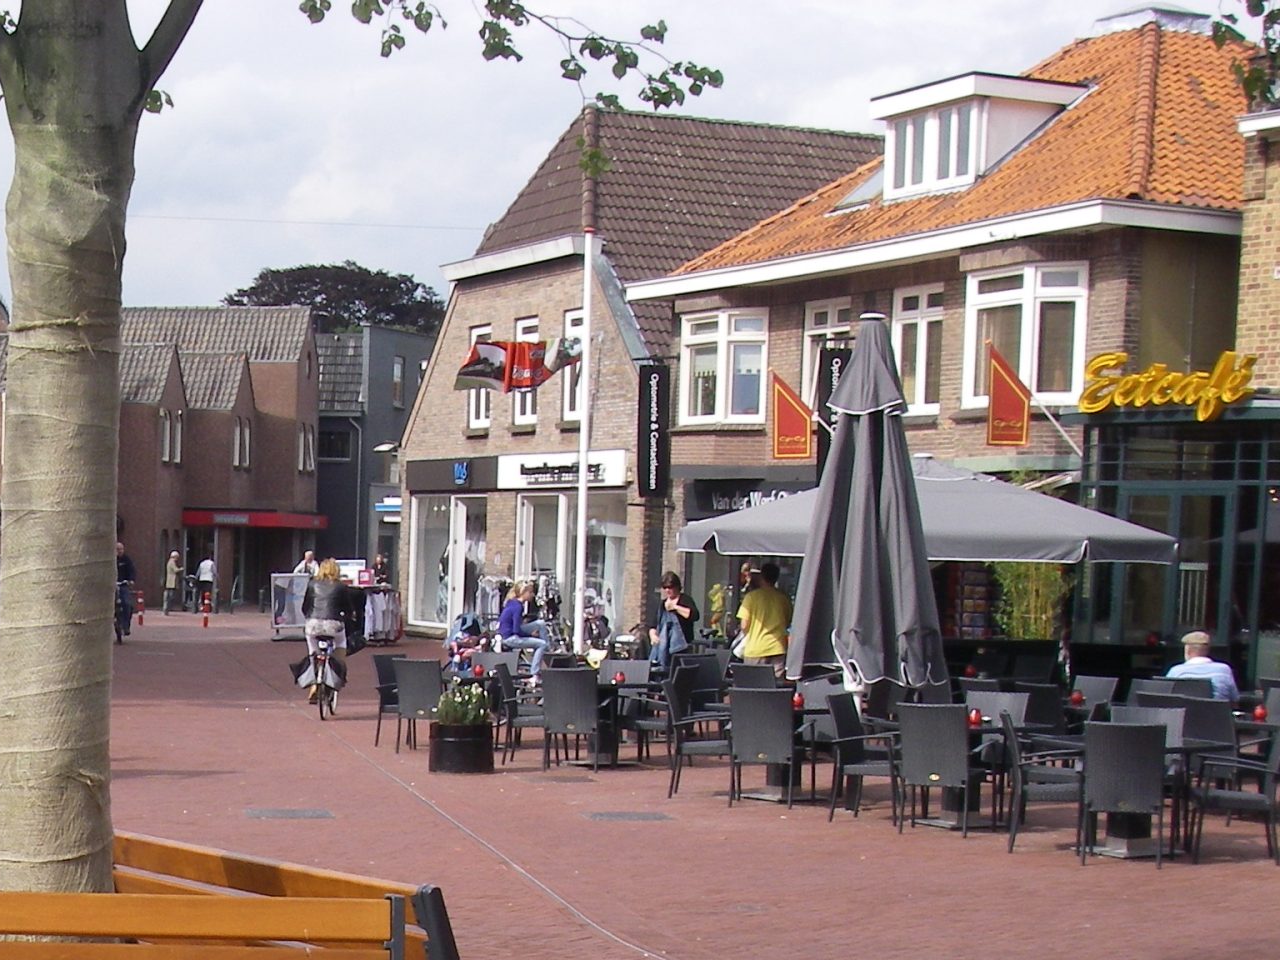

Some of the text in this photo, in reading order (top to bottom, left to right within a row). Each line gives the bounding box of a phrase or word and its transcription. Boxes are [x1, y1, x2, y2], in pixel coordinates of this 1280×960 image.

[1078, 351, 1258, 423] Eetcafé
[648, 373, 660, 490] Optometrie & Contactlenzen
[712, 491, 730, 510] Van
[731, 490, 749, 510] der
